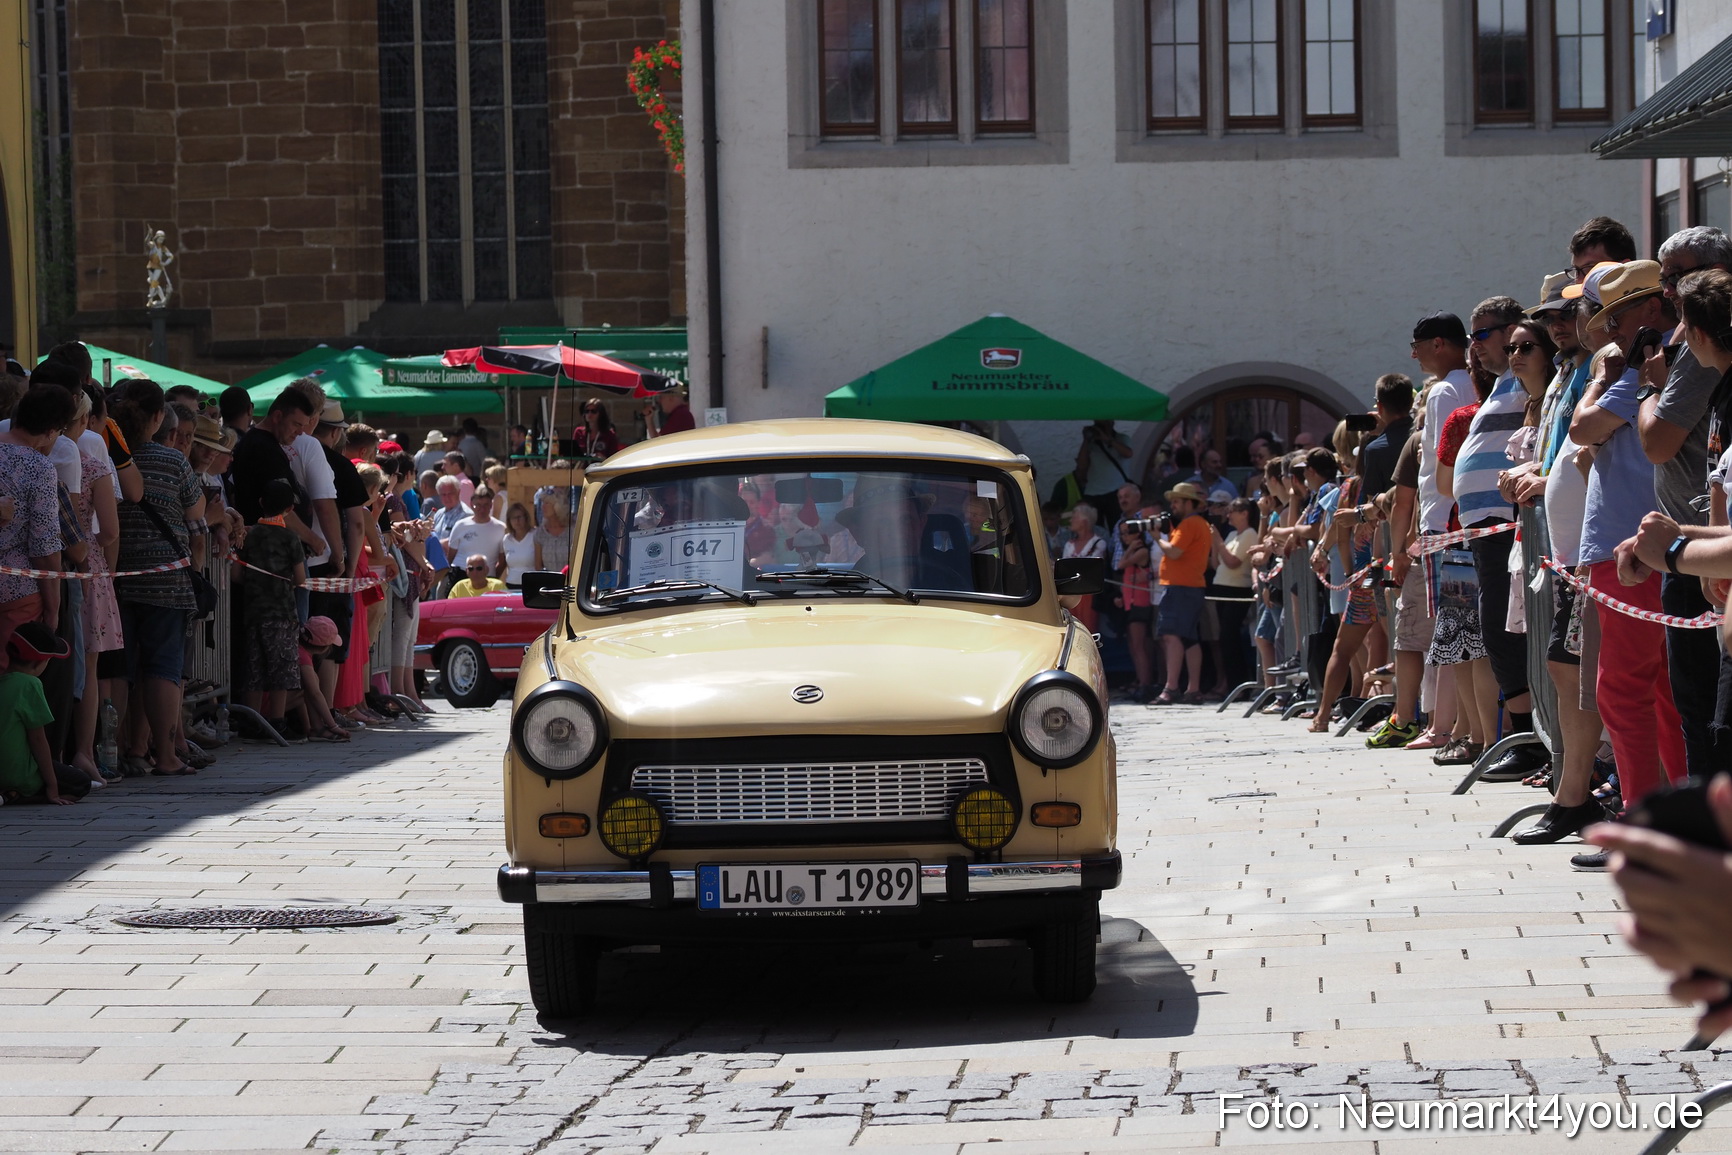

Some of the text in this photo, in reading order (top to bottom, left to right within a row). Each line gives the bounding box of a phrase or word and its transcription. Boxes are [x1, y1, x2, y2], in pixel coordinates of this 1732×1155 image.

[397, 369, 440, 384] Neumarkter
[931, 380, 1070, 391] Lammsbräu
[682, 539, 722, 557] 647
[722, 870, 782, 903] LAU
[706, 891, 713, 901] D
[772, 909, 846, 917] www.sixstarscars.de
